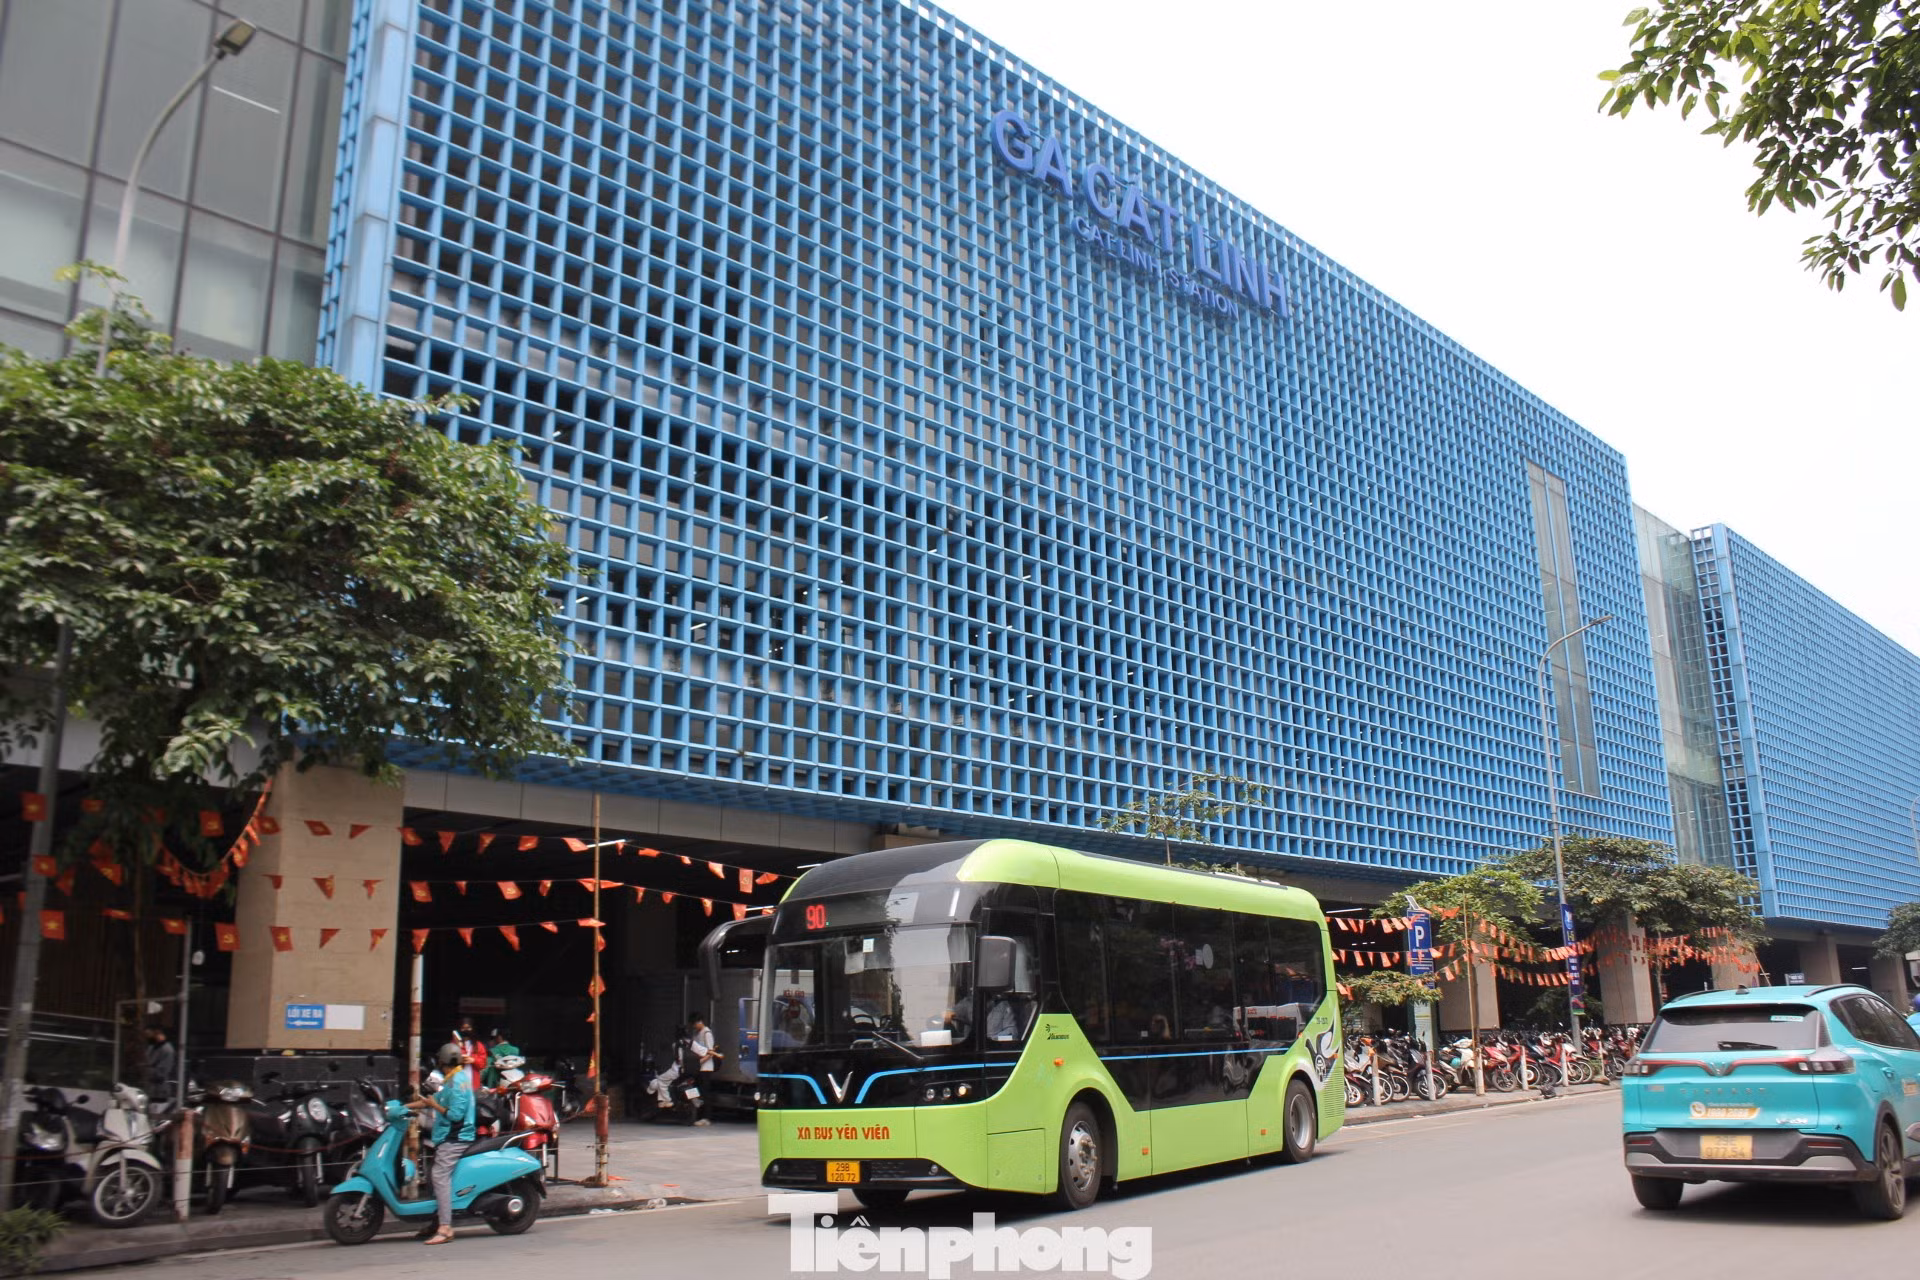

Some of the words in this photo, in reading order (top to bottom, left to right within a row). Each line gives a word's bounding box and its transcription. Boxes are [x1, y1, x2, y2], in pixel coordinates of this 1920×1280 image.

[991, 109, 1073, 199] GA
[1191, 223, 1289, 320] LINH
[1071, 216, 1115, 253] CAT
[1119, 239, 1162, 280] LINH
[1167, 267, 1239, 320] STATION
[806, 904, 826, 930] 90
[1415, 925, 1425, 948] P
[814, 1127, 833, 1140] BUS
[836, 1123, 858, 1140] YÊN
[831, 1173, 856, 1182] 120.72
[835, 1162, 850, 1172] 29B
